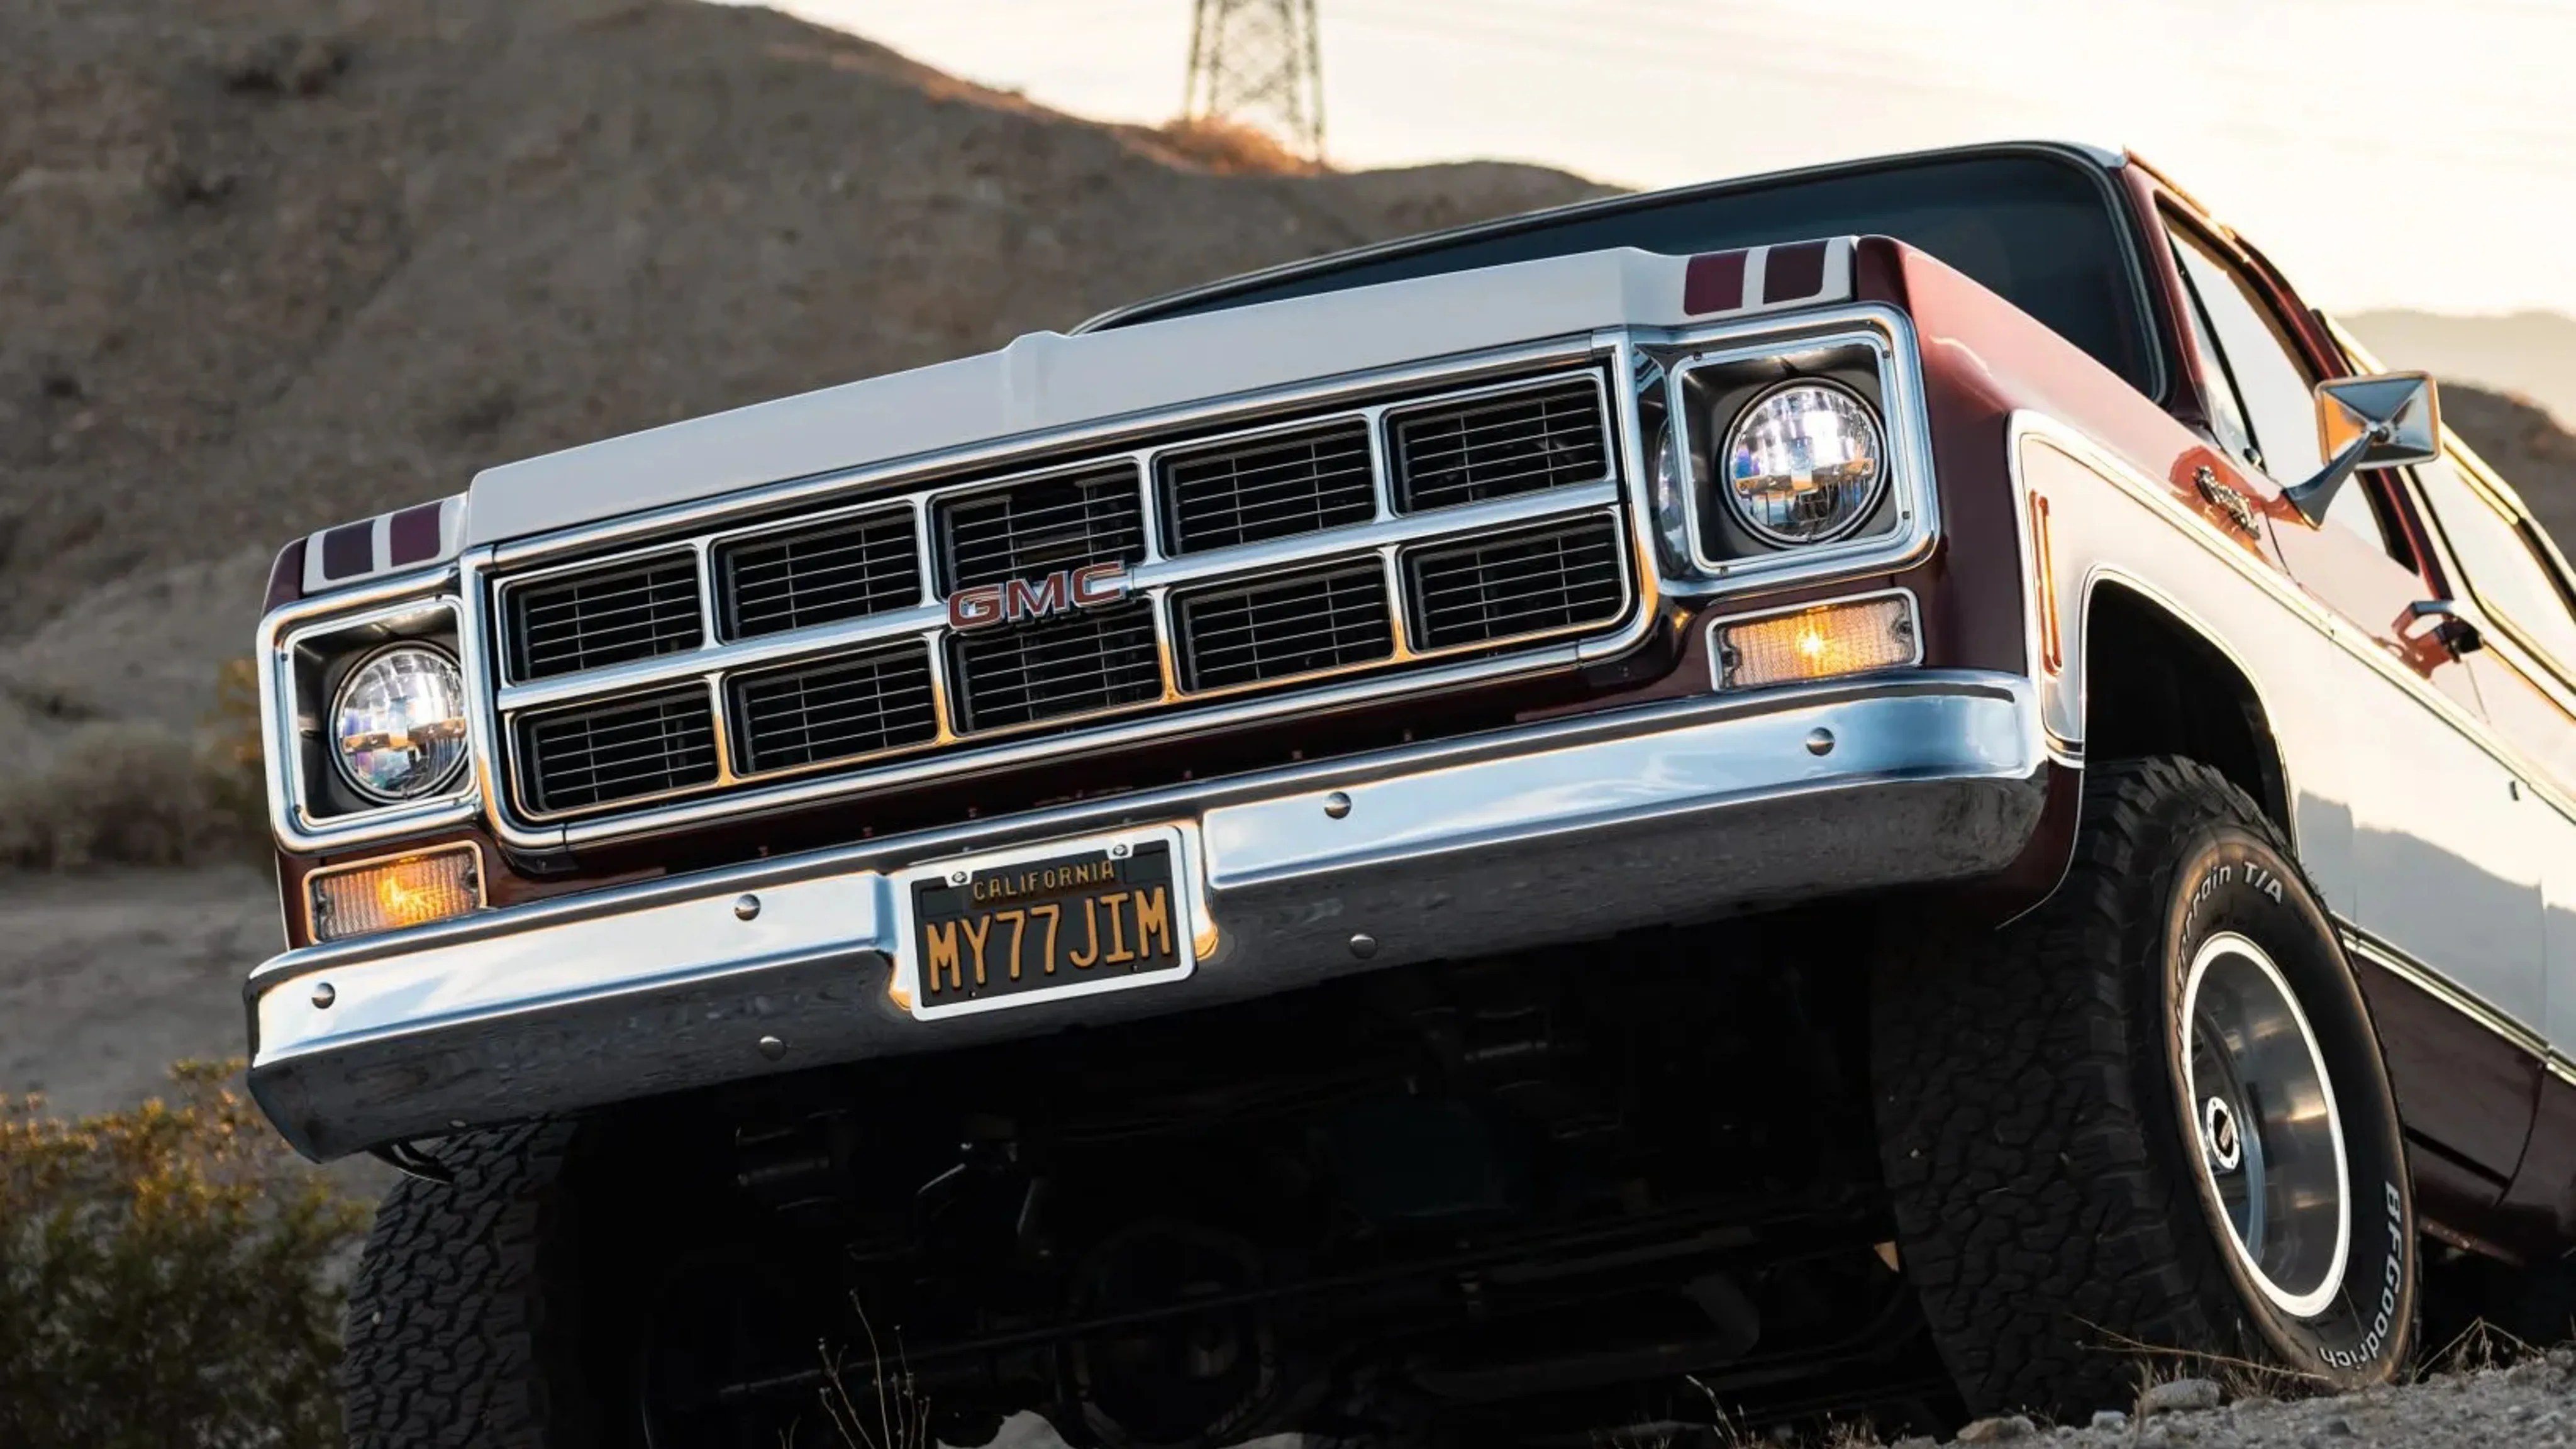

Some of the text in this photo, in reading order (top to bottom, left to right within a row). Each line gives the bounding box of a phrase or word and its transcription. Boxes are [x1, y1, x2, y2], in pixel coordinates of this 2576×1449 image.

[948, 560, 1128, 630] GMC
[973, 858, 1115, 901] CALIFORNIA
[2243, 860, 2283, 904] T/A
[926, 886, 1172, 993] MY77JIM
[2321, 1180, 2401, 1368] BFGoodrich
